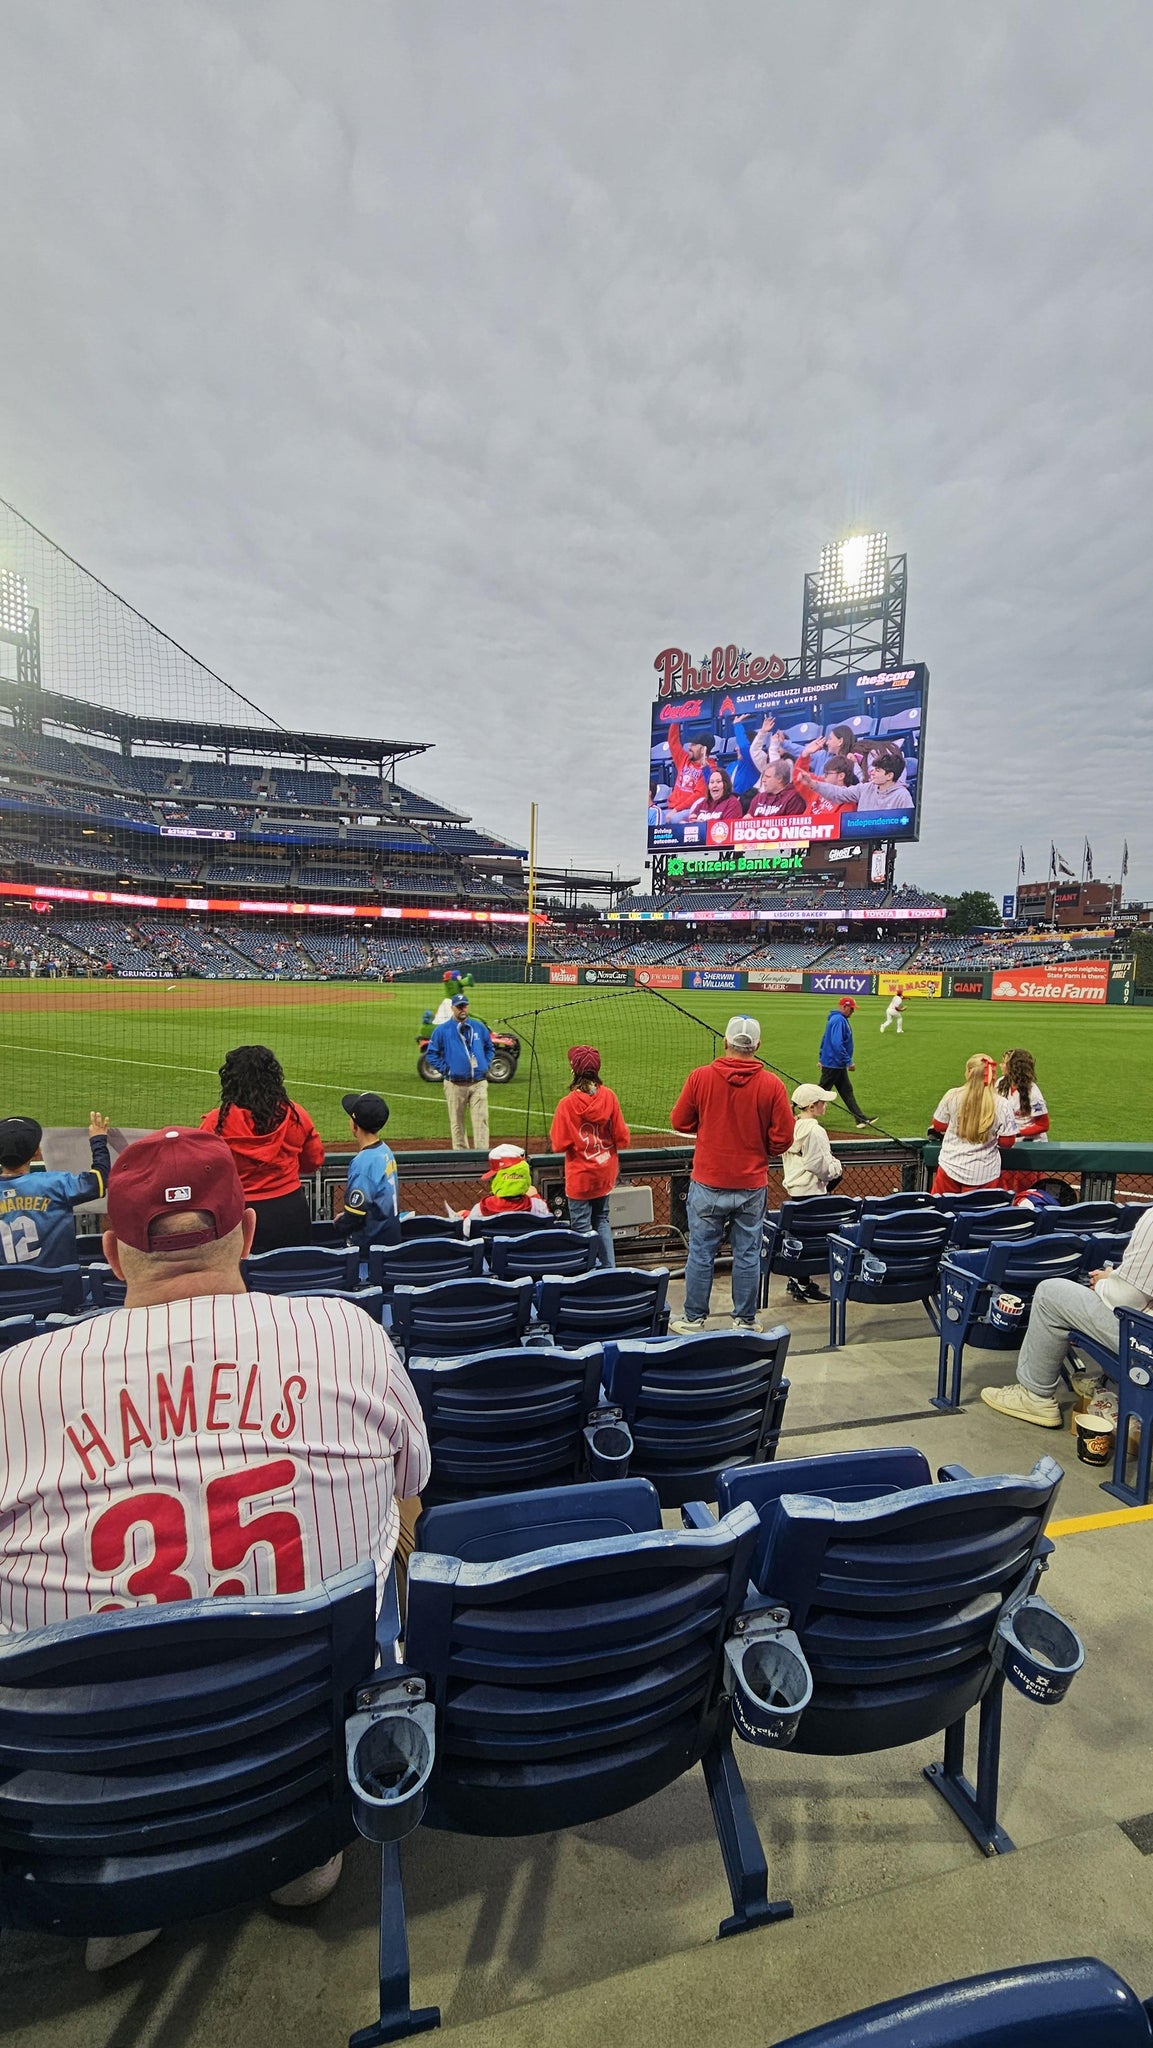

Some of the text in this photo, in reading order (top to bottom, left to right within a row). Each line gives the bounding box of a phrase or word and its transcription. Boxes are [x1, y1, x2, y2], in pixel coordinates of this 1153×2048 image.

[654, 644, 786, 697] Phillies
[856, 670, 916, 686] theScore
[736, 682, 839, 703] SALTZ MONGELUZZI BENDESKY
[754, 695, 818, 709] INJURY LAWYERS
[847, 817, 899, 828] Independence
[733, 824, 834, 842] BOGO NIGHT
[686, 854, 803, 873] Citizens Bank Park
[910, 910, 942, 918] TOYOTA
[551, 971, 576, 983] Wawa
[597, 970, 627, 979] NovaCare
[703, 972, 735, 981] SHERWIN
[1063, 965, 1078, 973] good
[814, 975, 866, 991] xfinity
[953, 981, 983, 993] GIANT
[0, 1215, 42, 1264] 12
[65, 1361, 308, 1482] HAMELS
[84, 1455, 310, 1613] 35
[1013, 1665, 1046, 1692] Citizens
[1025, 1684, 1046, 1698] Park
